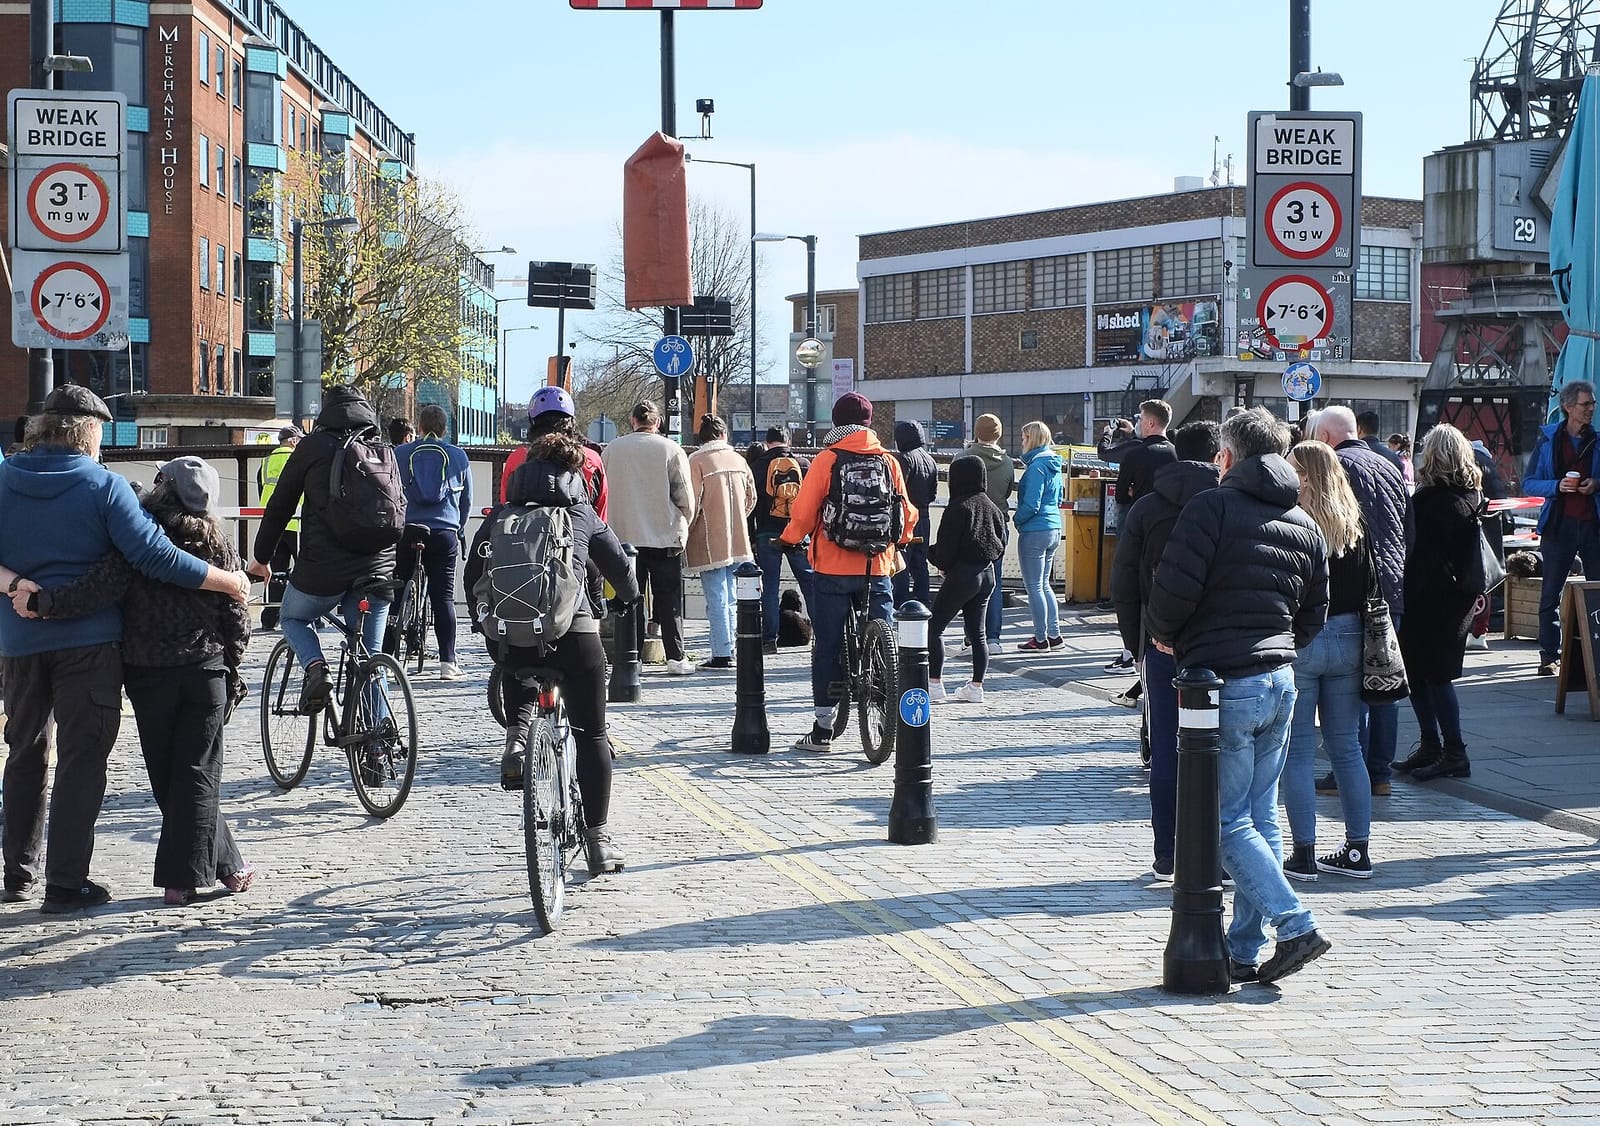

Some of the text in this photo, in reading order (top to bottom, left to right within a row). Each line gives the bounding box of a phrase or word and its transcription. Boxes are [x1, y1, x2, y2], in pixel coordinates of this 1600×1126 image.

[36, 108, 99, 126] WEAK
[27, 129, 107, 147] BRIDGE
[1273, 128, 1336, 145] WEAK
[1266, 149, 1342, 166] BRIDGE
[1514, 217, 1536, 242] 29
